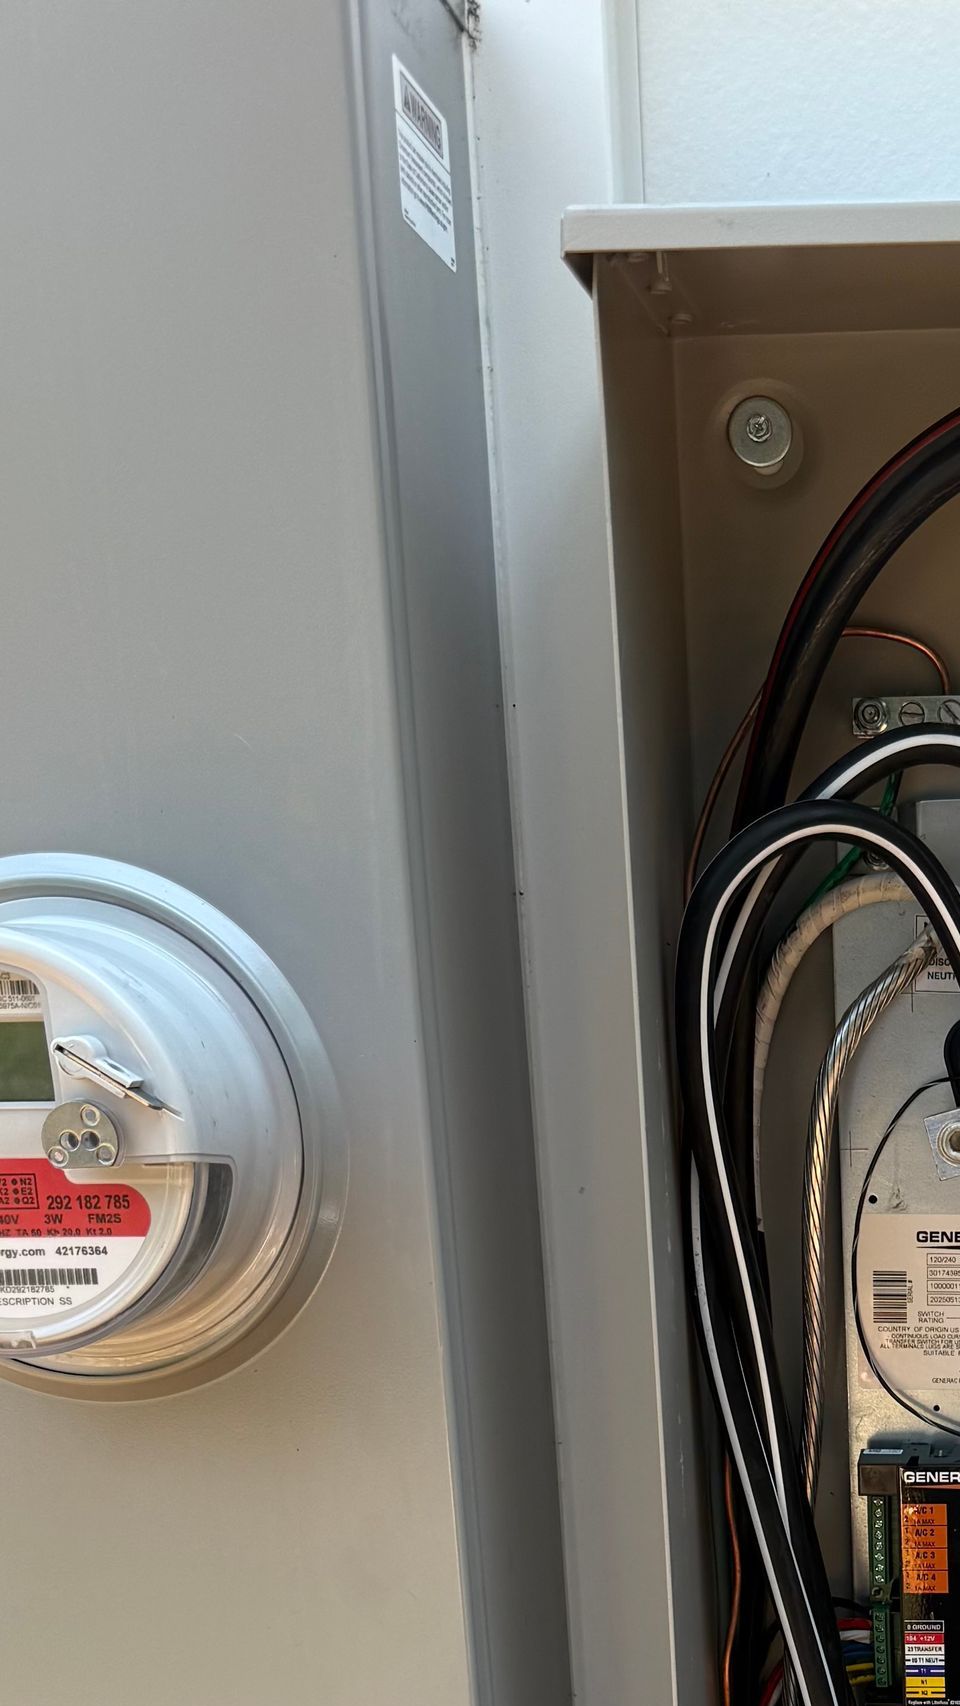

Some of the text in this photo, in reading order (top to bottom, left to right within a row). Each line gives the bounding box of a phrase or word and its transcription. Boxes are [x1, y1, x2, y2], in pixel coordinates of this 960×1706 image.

[46, 1194, 131, 1210] 292 182 785
[44, 1214, 63, 1225] 3W
[87, 1213, 122, 1224] FM2S
[55, 1246, 108, 1256] 42176364
[0, 1297, 73, 1306] SCRIPTION SS
[915, 1529, 928, 1537] A/C
[915, 1551, 936, 1560] A/C 3
[916, 1573, 936, 1581] A/C 4
